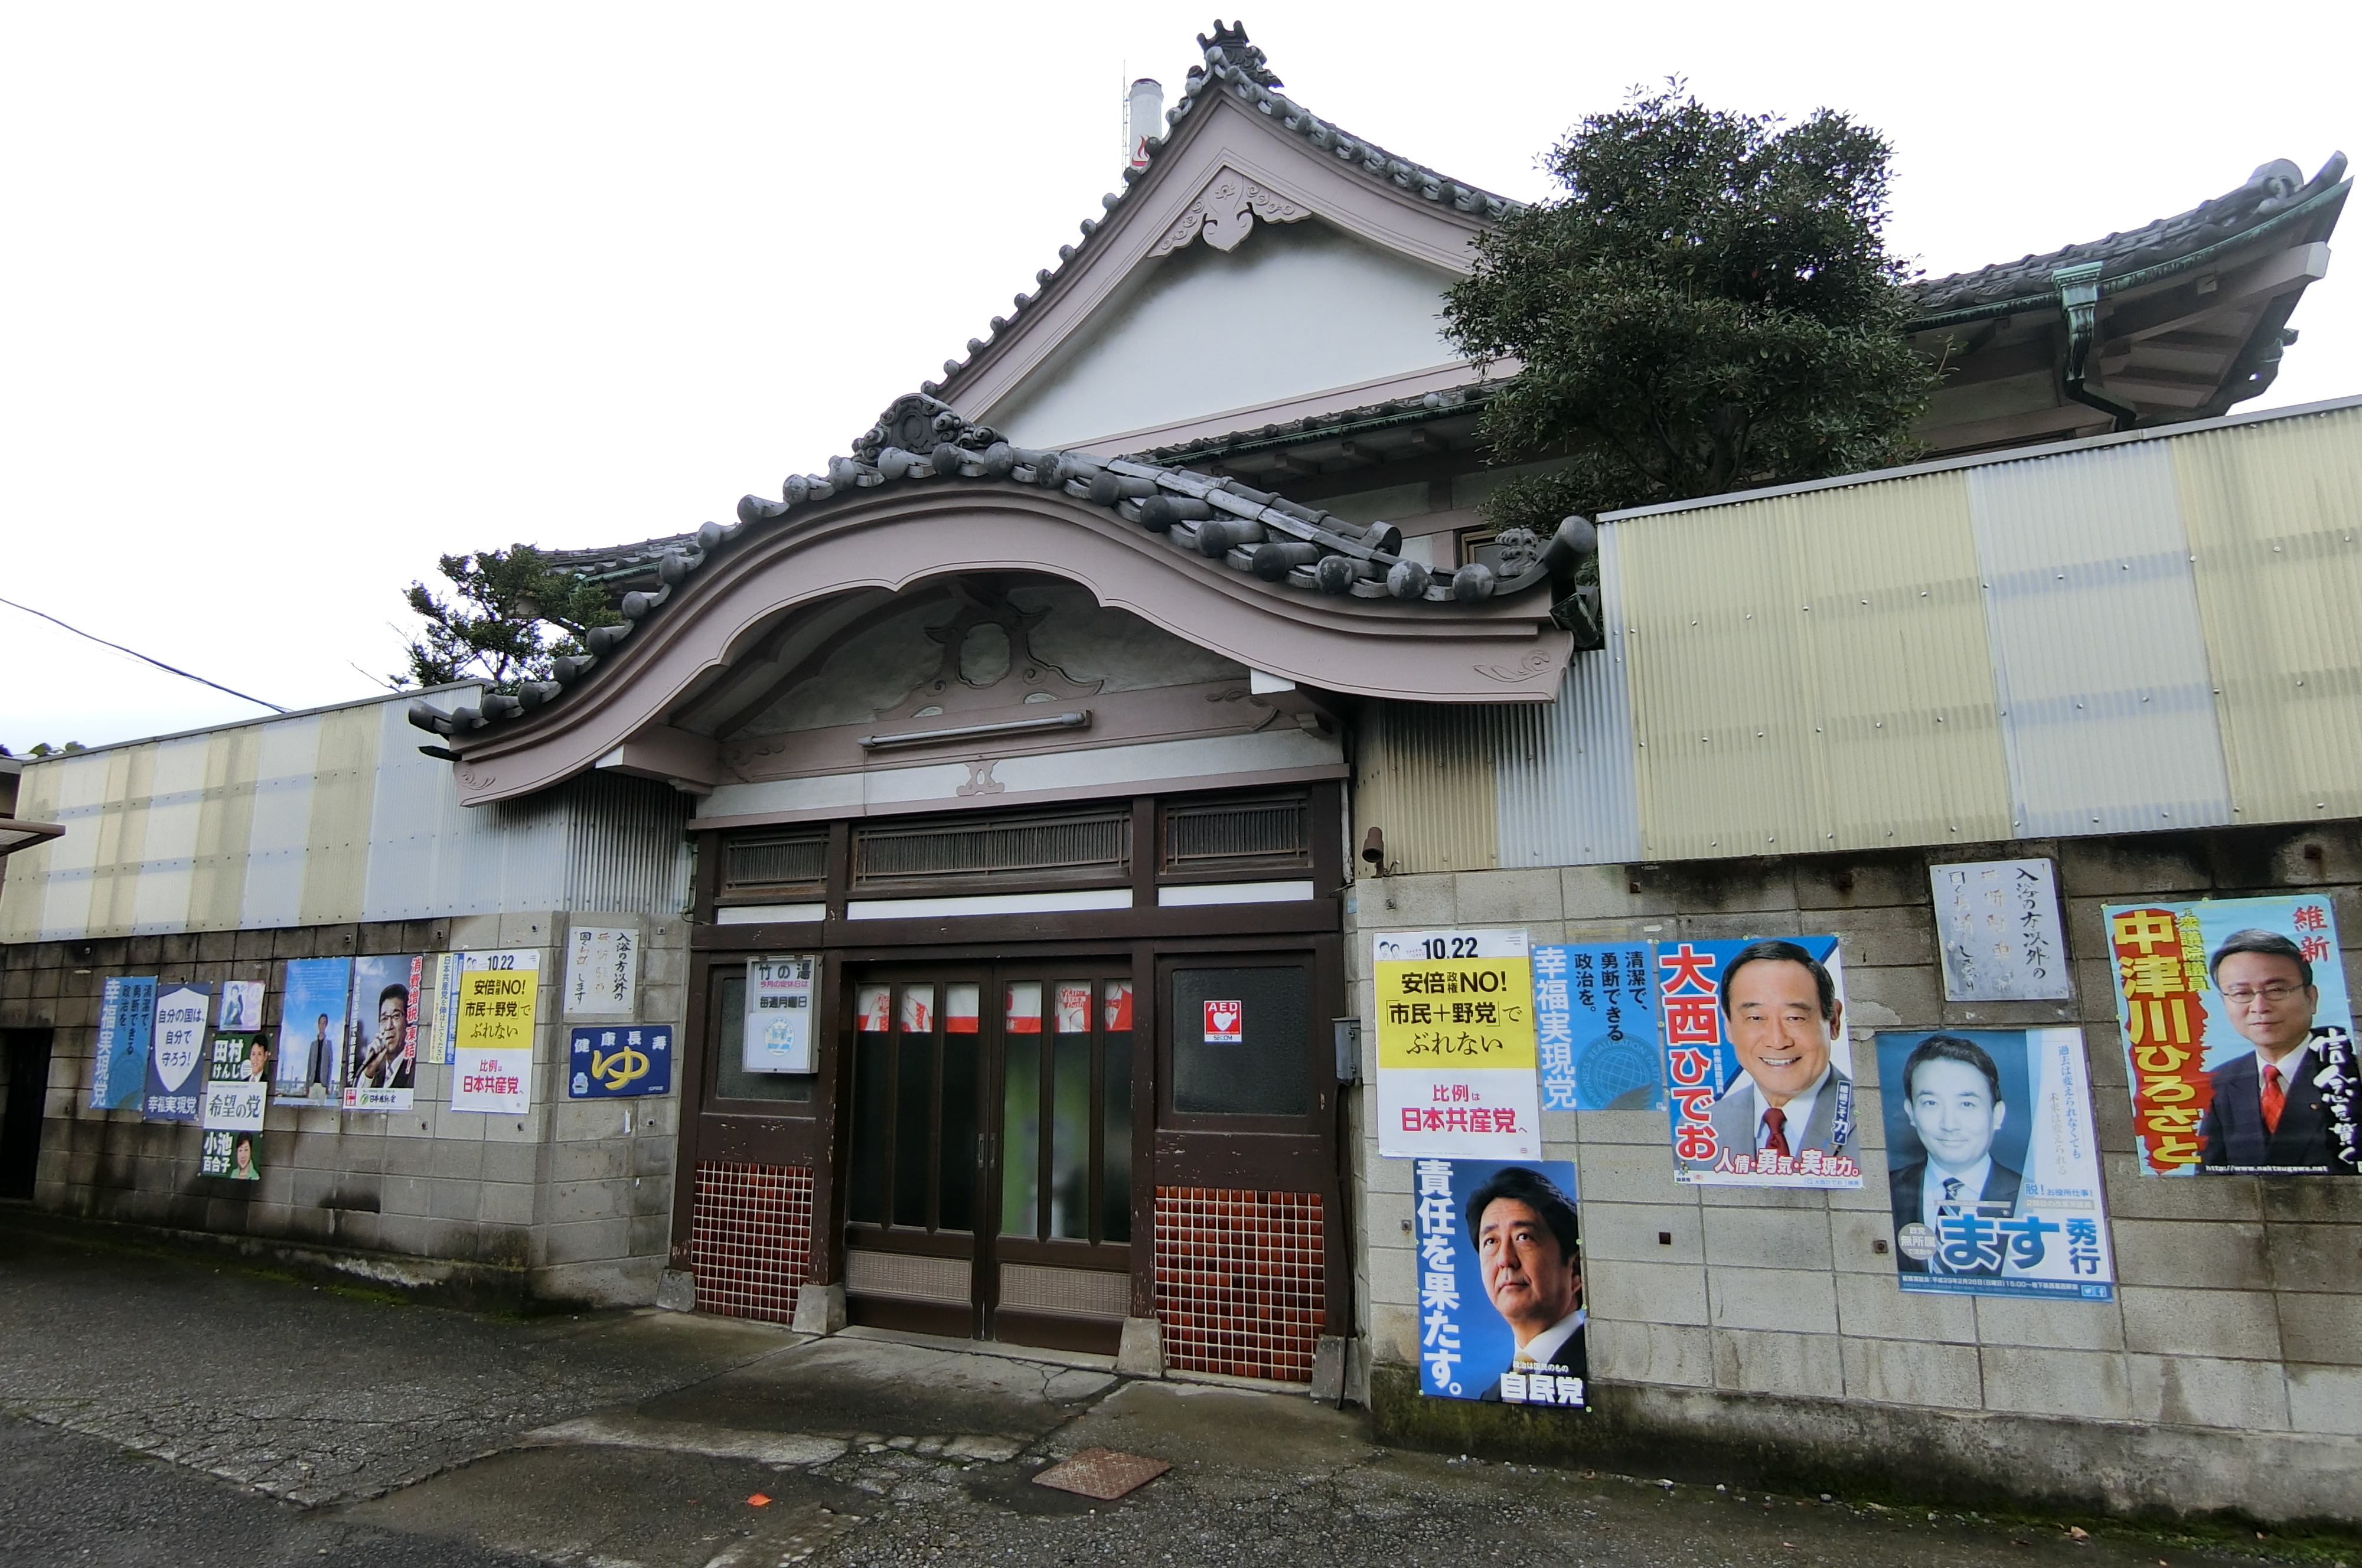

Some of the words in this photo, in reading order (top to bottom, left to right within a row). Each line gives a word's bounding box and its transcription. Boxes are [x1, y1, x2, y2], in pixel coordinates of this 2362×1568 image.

[2016, 867, 2050, 979] 入浴の方以外の
[2294, 905, 2331, 965] 維新
[1421, 936, 1479, 960] 10.22
[487, 955, 514, 971] 10.22
[612, 932, 631, 1002] 入浴の方以外の
[759, 962, 812, 981] 竹の湯
[760, 980, 808, 988] 今月の定休日は
[1401, 971, 1507, 994] 安倍政権NO!
[1574, 953, 1597, 1012] 政治を。
[1625, 951, 1648, 1011] 清潔で、
[760, 995, 808, 1008] 毎週月曜日
[1208, 1002, 1238, 1012] AED
[1601, 952, 1623, 1042] 勇断できる
[126, 985, 142, 1055] 勇断できる
[158, 1008, 205, 1024] 自分の国は、
[1534, 948, 1576, 1109] 幸福実現党
[92, 979, 120, 1106] 幸福実現党
[165, 1030, 193, 1045] 自分で
[470, 1022, 518, 1040] ぶれない
[574, 1030, 667, 1053] 健康長寿
[2113, 910, 2203, 1164] 中津川ひろさと
[213, 1038, 244, 1063] 田村
[1406, 1032, 1503, 1056] ぶれない
[1660, 945, 1719, 1160] 大西ひでお
[162, 1051, 192, 1067] 守ろう!
[213, 1063, 240, 1080] けんじ
[479, 1059, 503, 1073] 比例は
[592, 1046, 650, 1090] ゆ
[1588, 1039, 1647, 1060] REALIZATION
[1646, 1055, 1662, 1084] PARTY
[464, 1075, 524, 1095] 日本共産党へ
[1433, 1084, 1480, 1102] 比例は
[2308, 1027, 2358, 1165] 信念を貫く
[148, 1095, 197, 1114] 幸福実現党
[210, 1094, 262, 1118] 希望の党
[2058, 1046, 2080, 1159] 過去は変えられなくても
[1401, 1107, 1528, 1133] 日本共産党へ
[204, 1131, 233, 1156] 小池
[2049, 1093, 2067, 1175] 未来は変えられる
[203, 1156, 231, 1173] 百合子
[1900, 1235, 1936, 1248] 無所属
[1940, 1213, 2060, 1270] ます
[2066, 1217, 2100, 1275] 秀行
[1417, 1159, 1462, 1396] 責任を果たす。
[1500, 1371, 1584, 1404] 自民党
